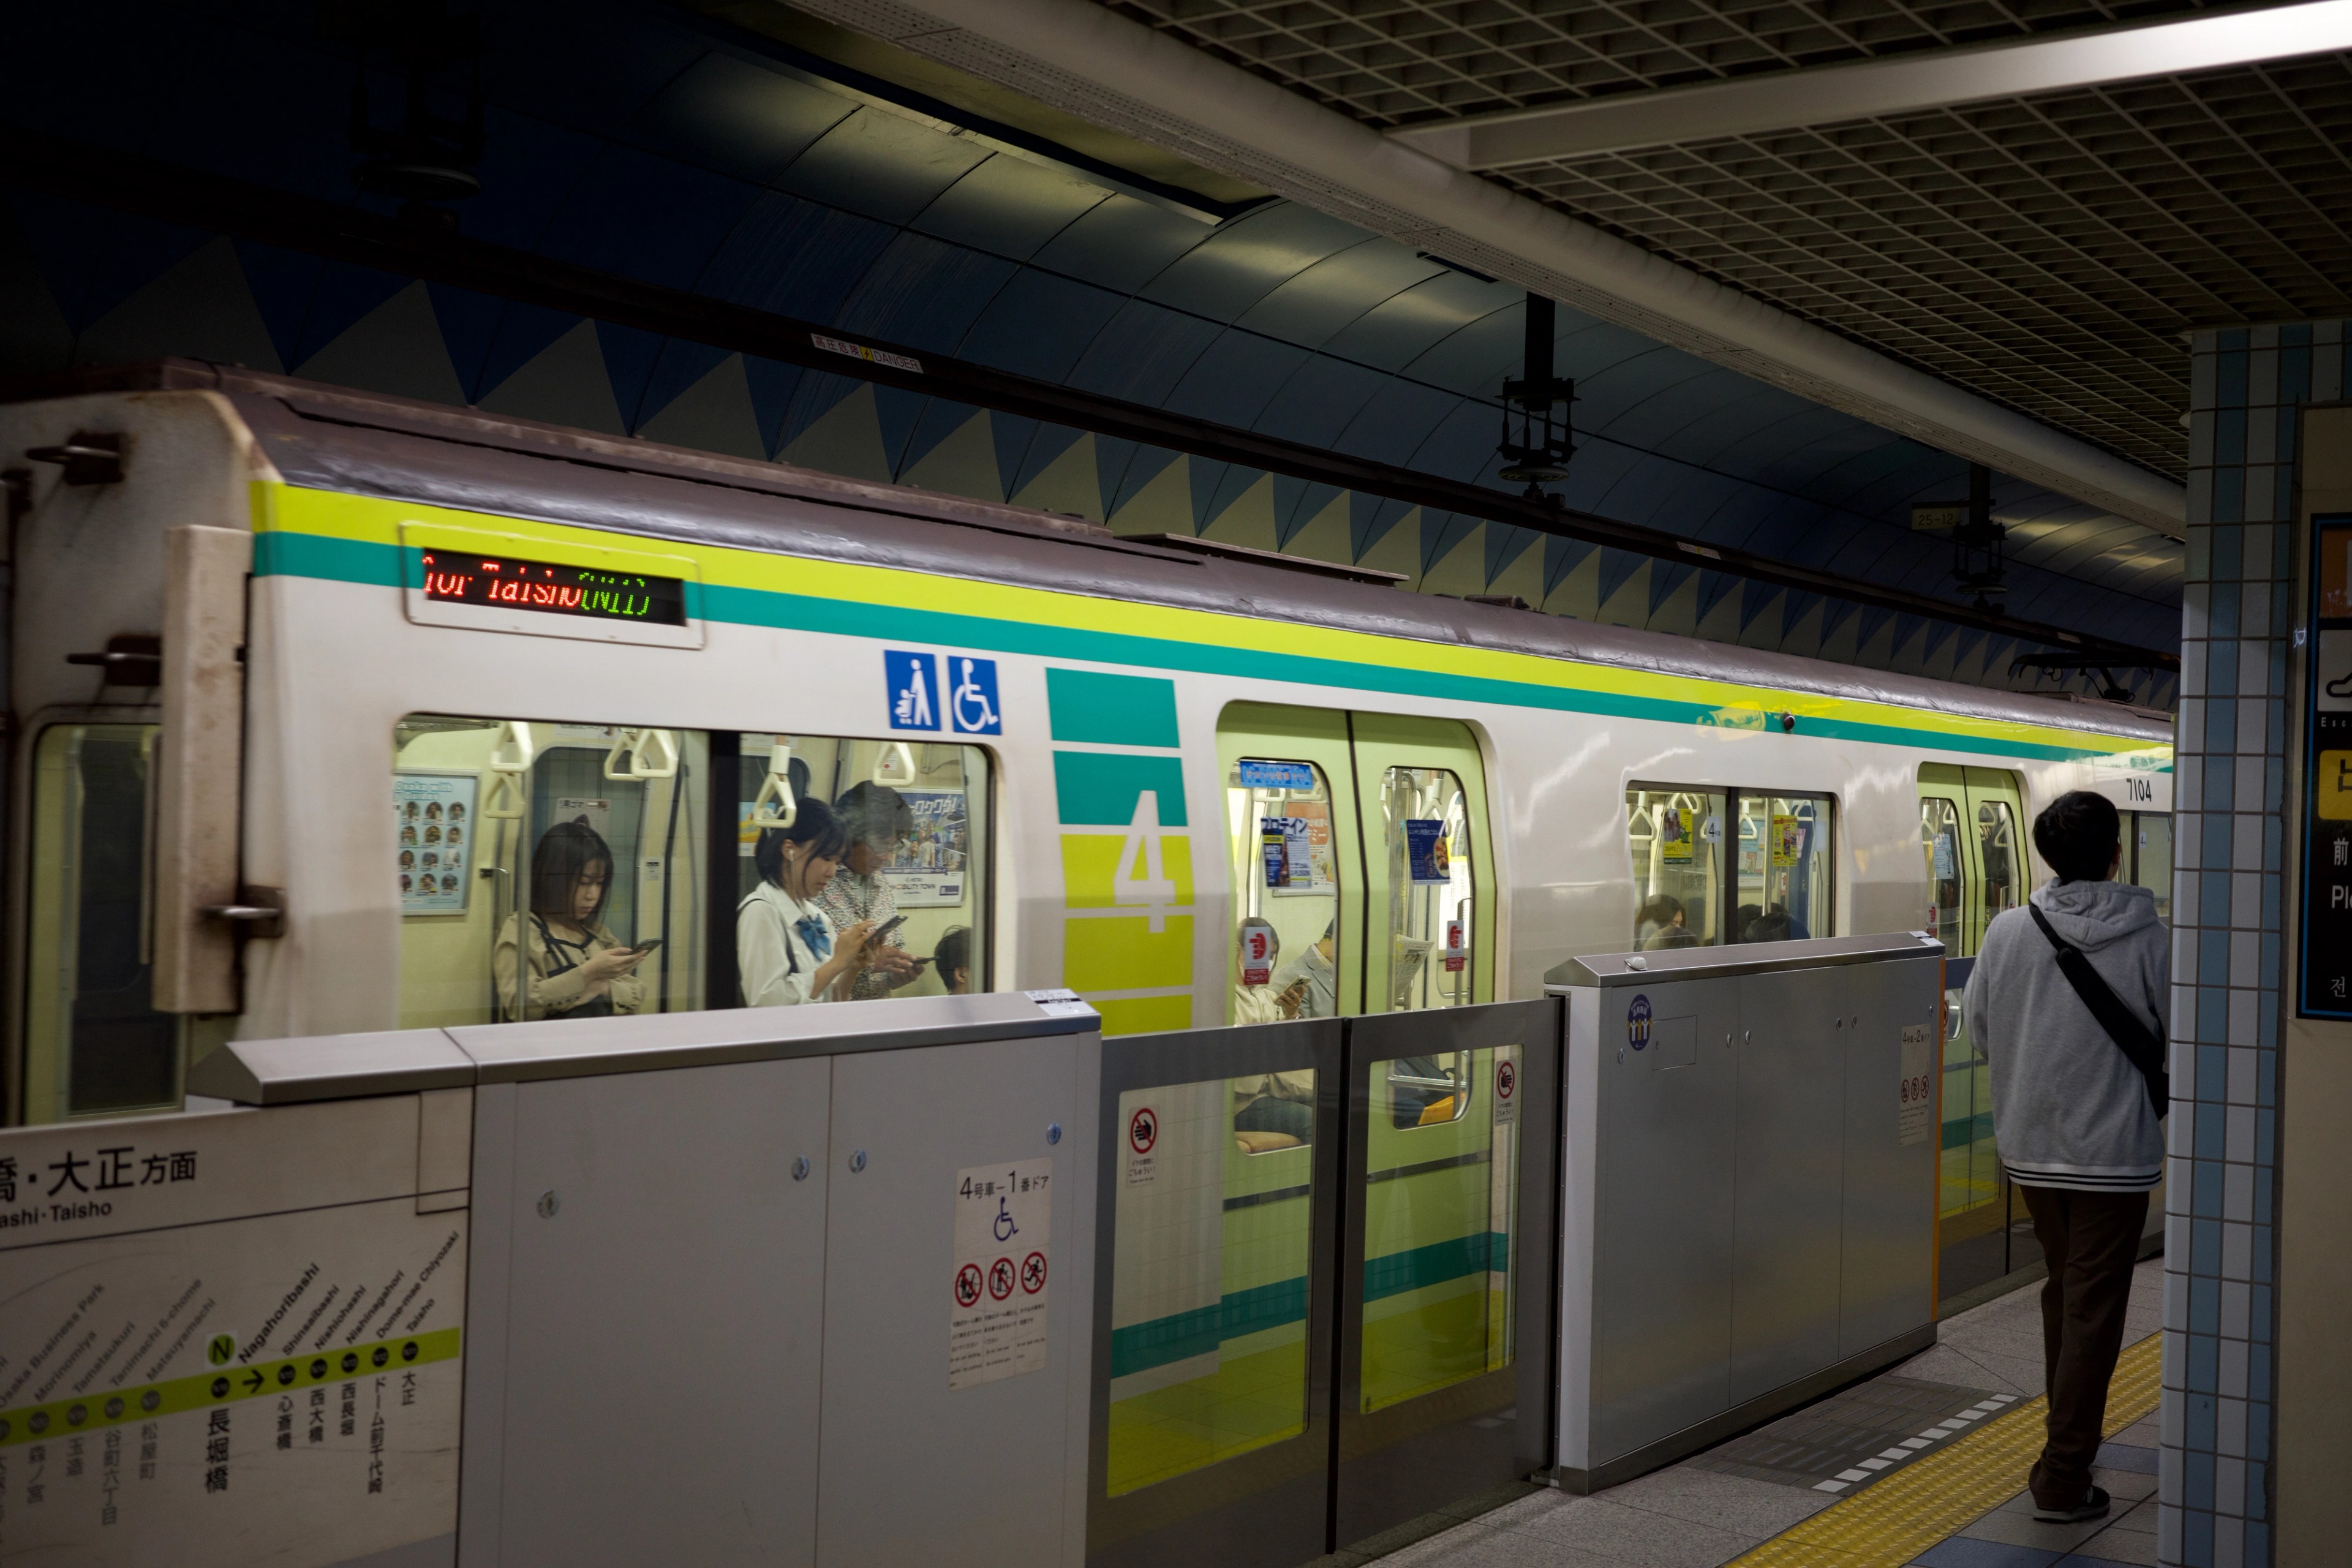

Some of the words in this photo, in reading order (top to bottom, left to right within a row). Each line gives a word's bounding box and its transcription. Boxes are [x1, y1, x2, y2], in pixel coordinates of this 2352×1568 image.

[814, 334, 861, 356] 高圧危険
[873, 350, 920, 371] DANGER
[1918, 513, 1954, 526] 25-12
[2321, 715, 2352, 728] Esc
[2125, 778, 2152, 802] 7104
[1261, 818, 1308, 835] プロテイン
[1114, 790, 1176, 933] 4
[2333, 837, 2350, 867] 前
[2330, 976, 2347, 1000] 전
[238, 1262, 321, 1365] Nagahoribashi
[405, 1297, 435, 1333] Taisho
[212, 1337, 232, 1362] N
[401, 1371, 417, 1406] 大正
[205, 1408, 231, 1494] 長堀橋
